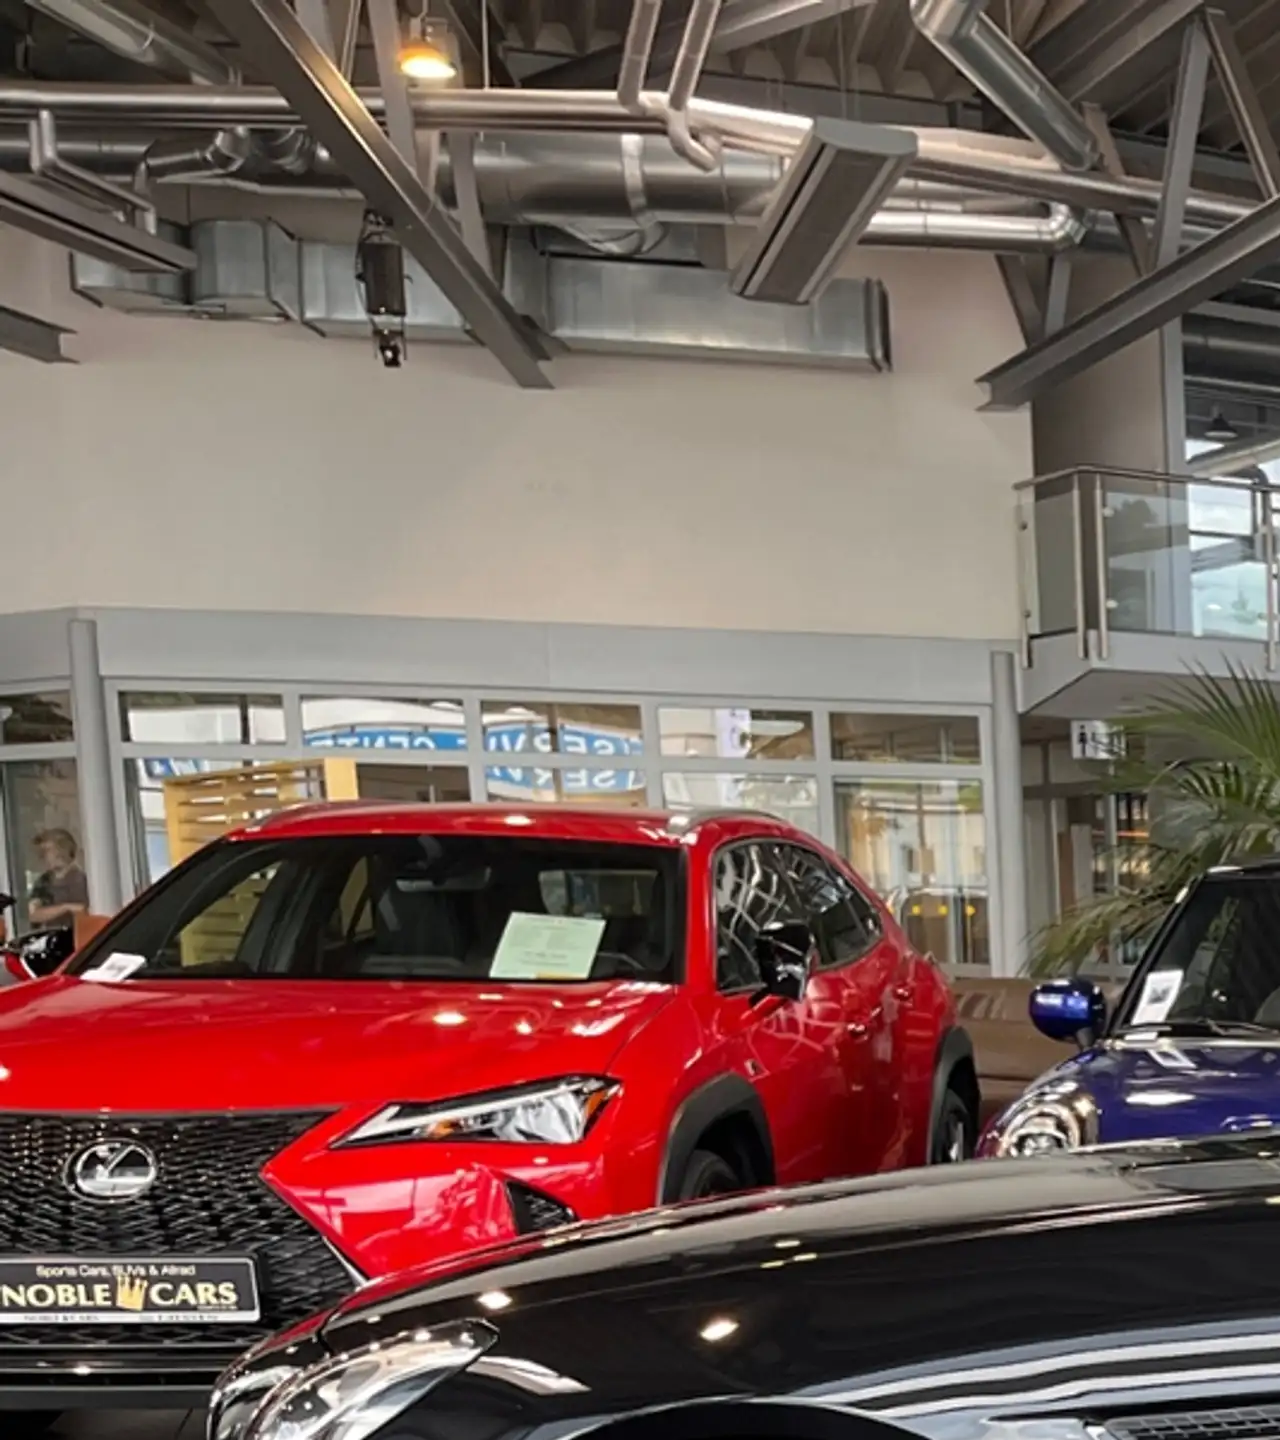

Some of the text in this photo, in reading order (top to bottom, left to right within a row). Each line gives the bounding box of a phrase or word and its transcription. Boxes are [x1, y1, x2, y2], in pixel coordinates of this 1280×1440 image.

[36, 1264, 77, 1278] Sports
[149, 1264, 159, 1276] &
[1, 1281, 238, 1307] NOBLE CARS
